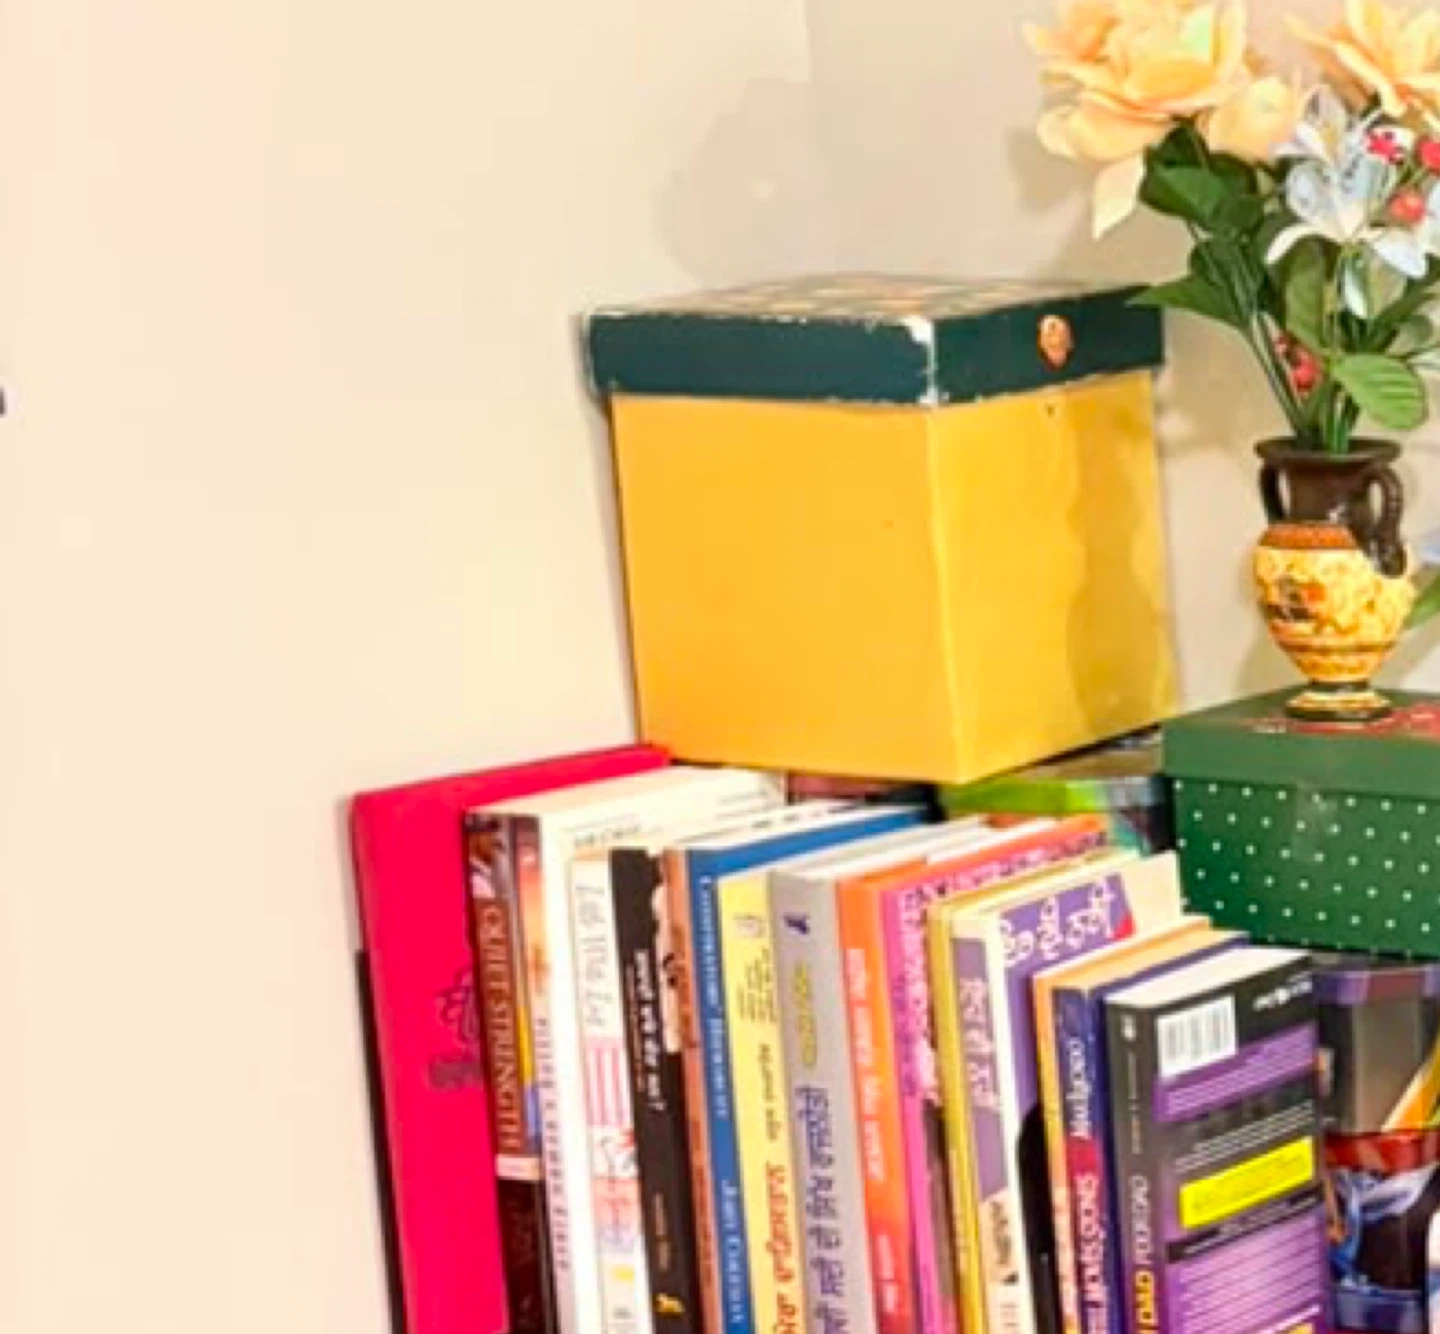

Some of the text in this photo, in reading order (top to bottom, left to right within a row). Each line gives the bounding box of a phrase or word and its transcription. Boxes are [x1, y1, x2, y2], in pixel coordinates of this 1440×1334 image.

[479, 904, 525, 1150] QUIET STRENGTH
[1132, 1269, 1156, 1324] DAD
